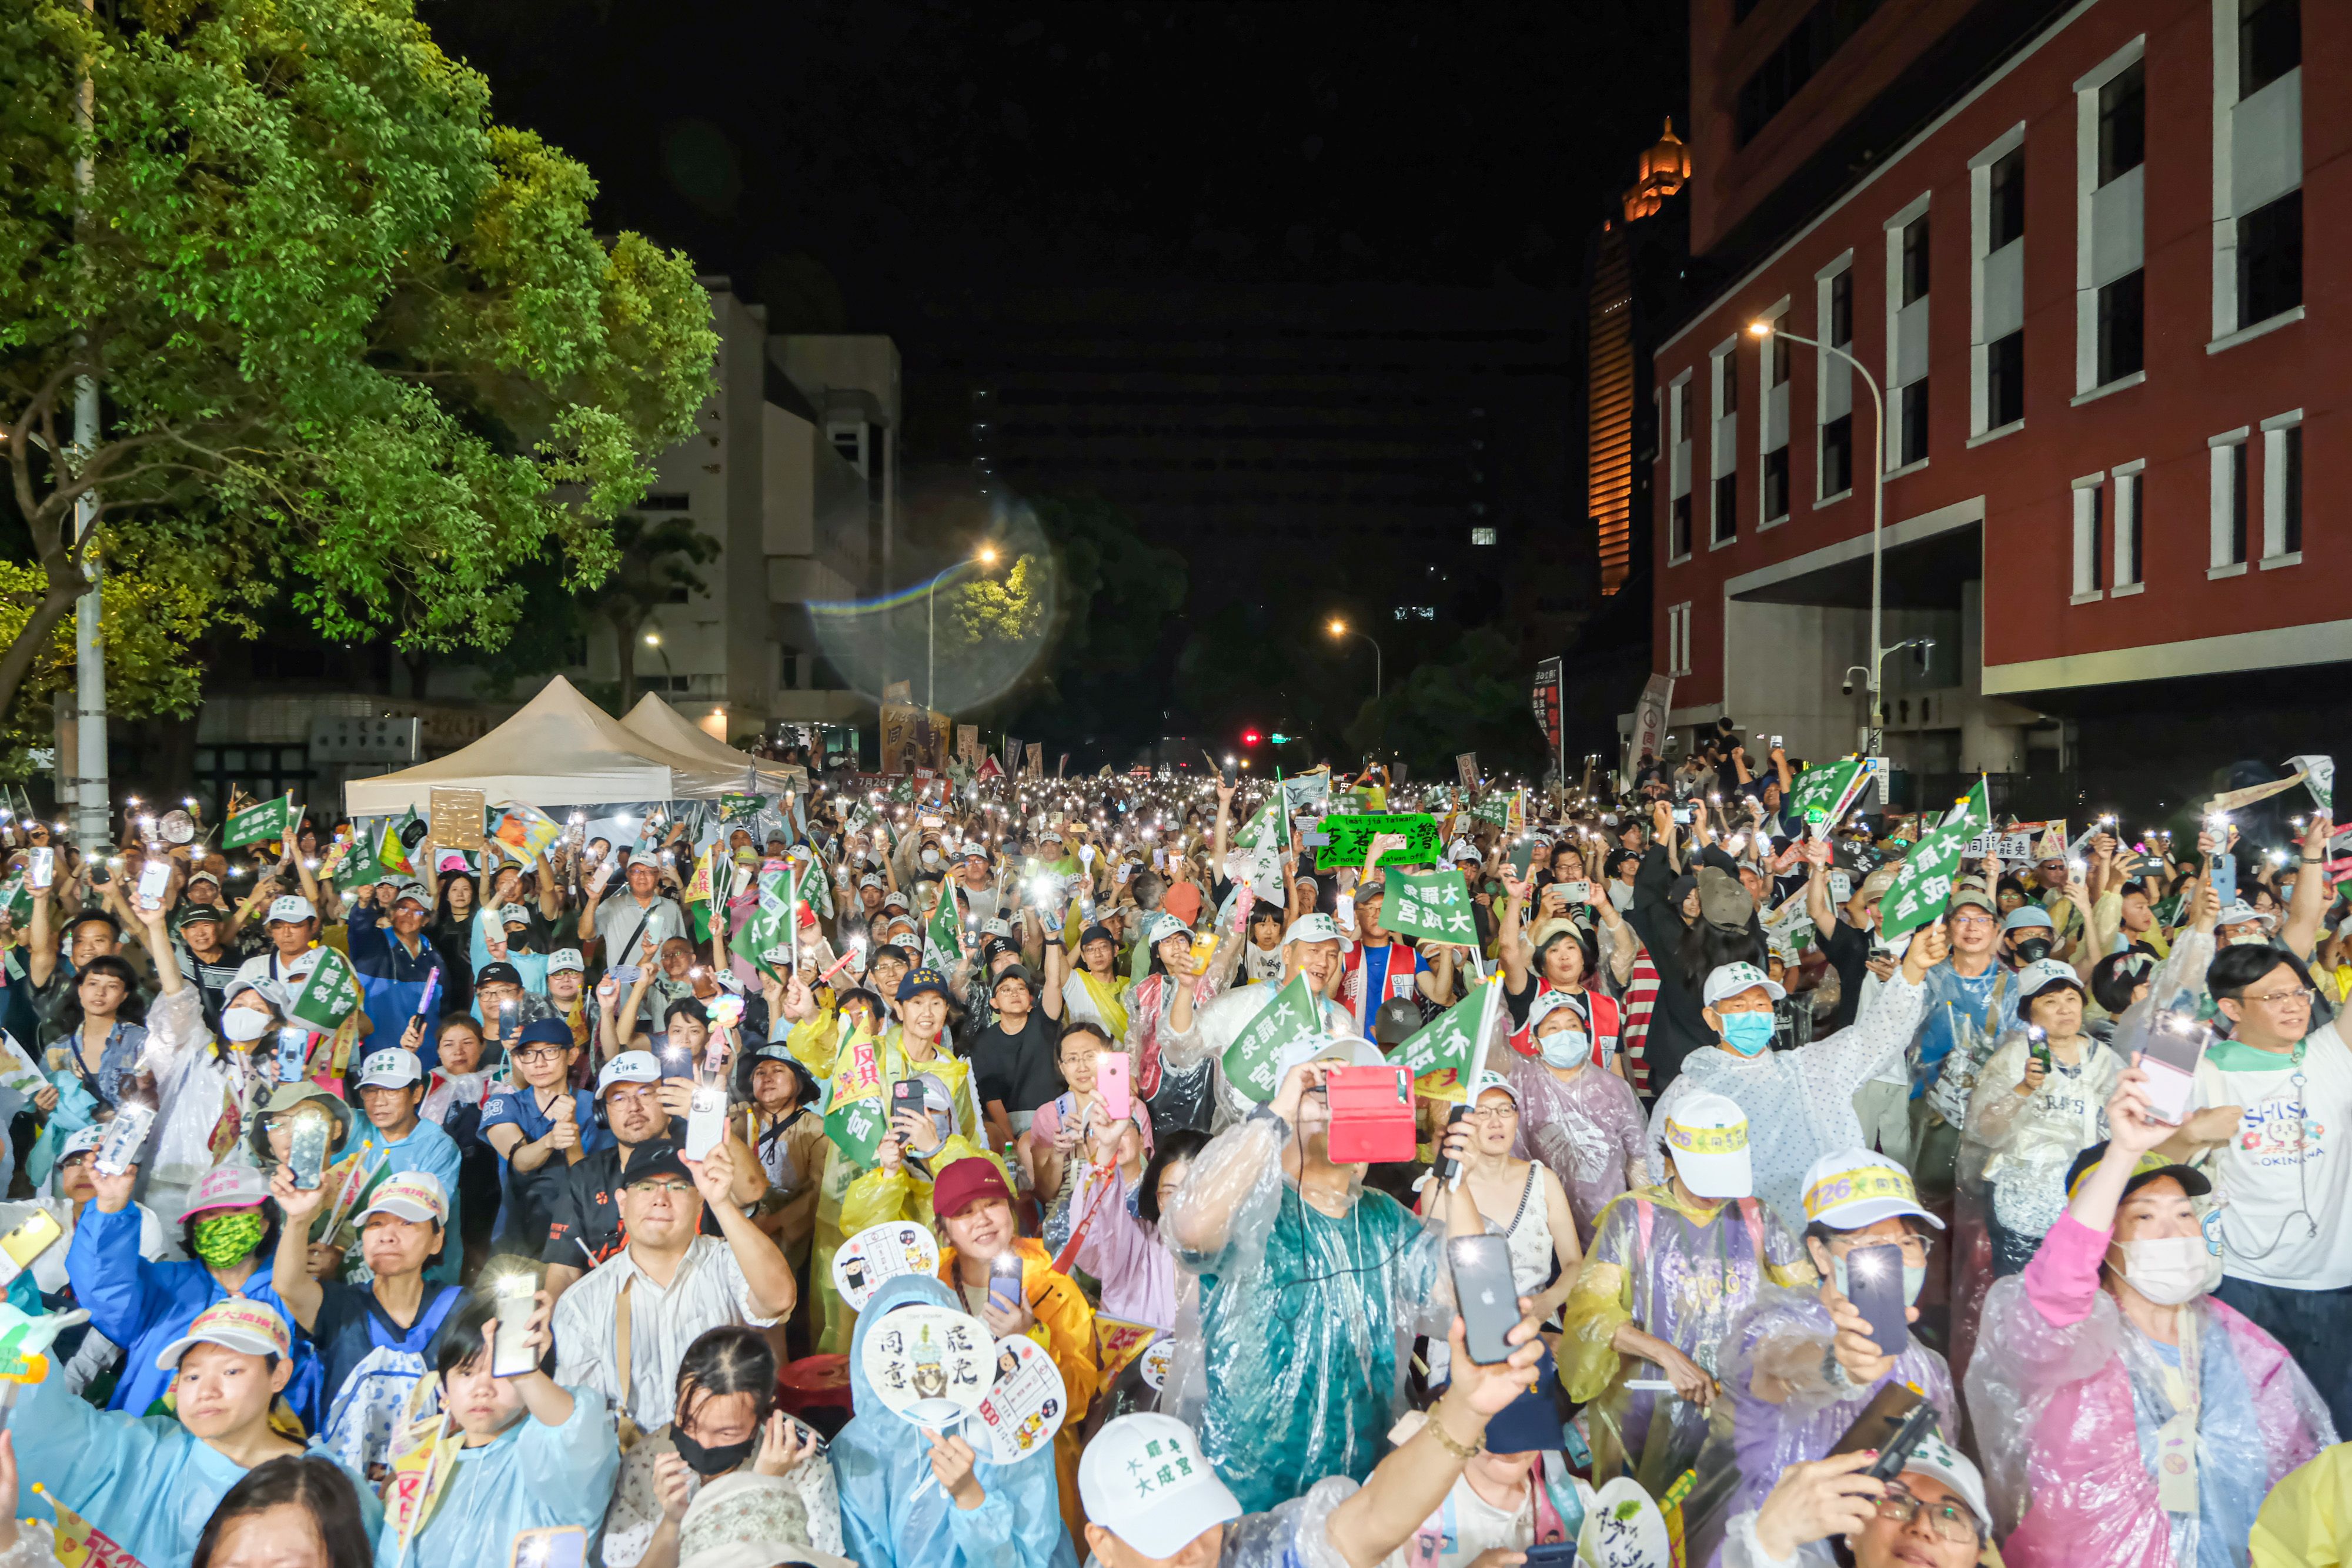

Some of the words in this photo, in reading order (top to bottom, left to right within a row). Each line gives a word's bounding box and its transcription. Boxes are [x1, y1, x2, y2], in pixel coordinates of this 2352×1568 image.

[859, 777, 895, 787] 7月26日
[1868, 761, 1876, 771] P
[1320, 823, 1440, 860] 莫惹灣
[698, 868, 710, 894] 反共
[854, 1043, 881, 1089] 反共
[1127, 1437, 1181, 1476] 大罷免
[1134, 1456, 1193, 1499] 大成宮
